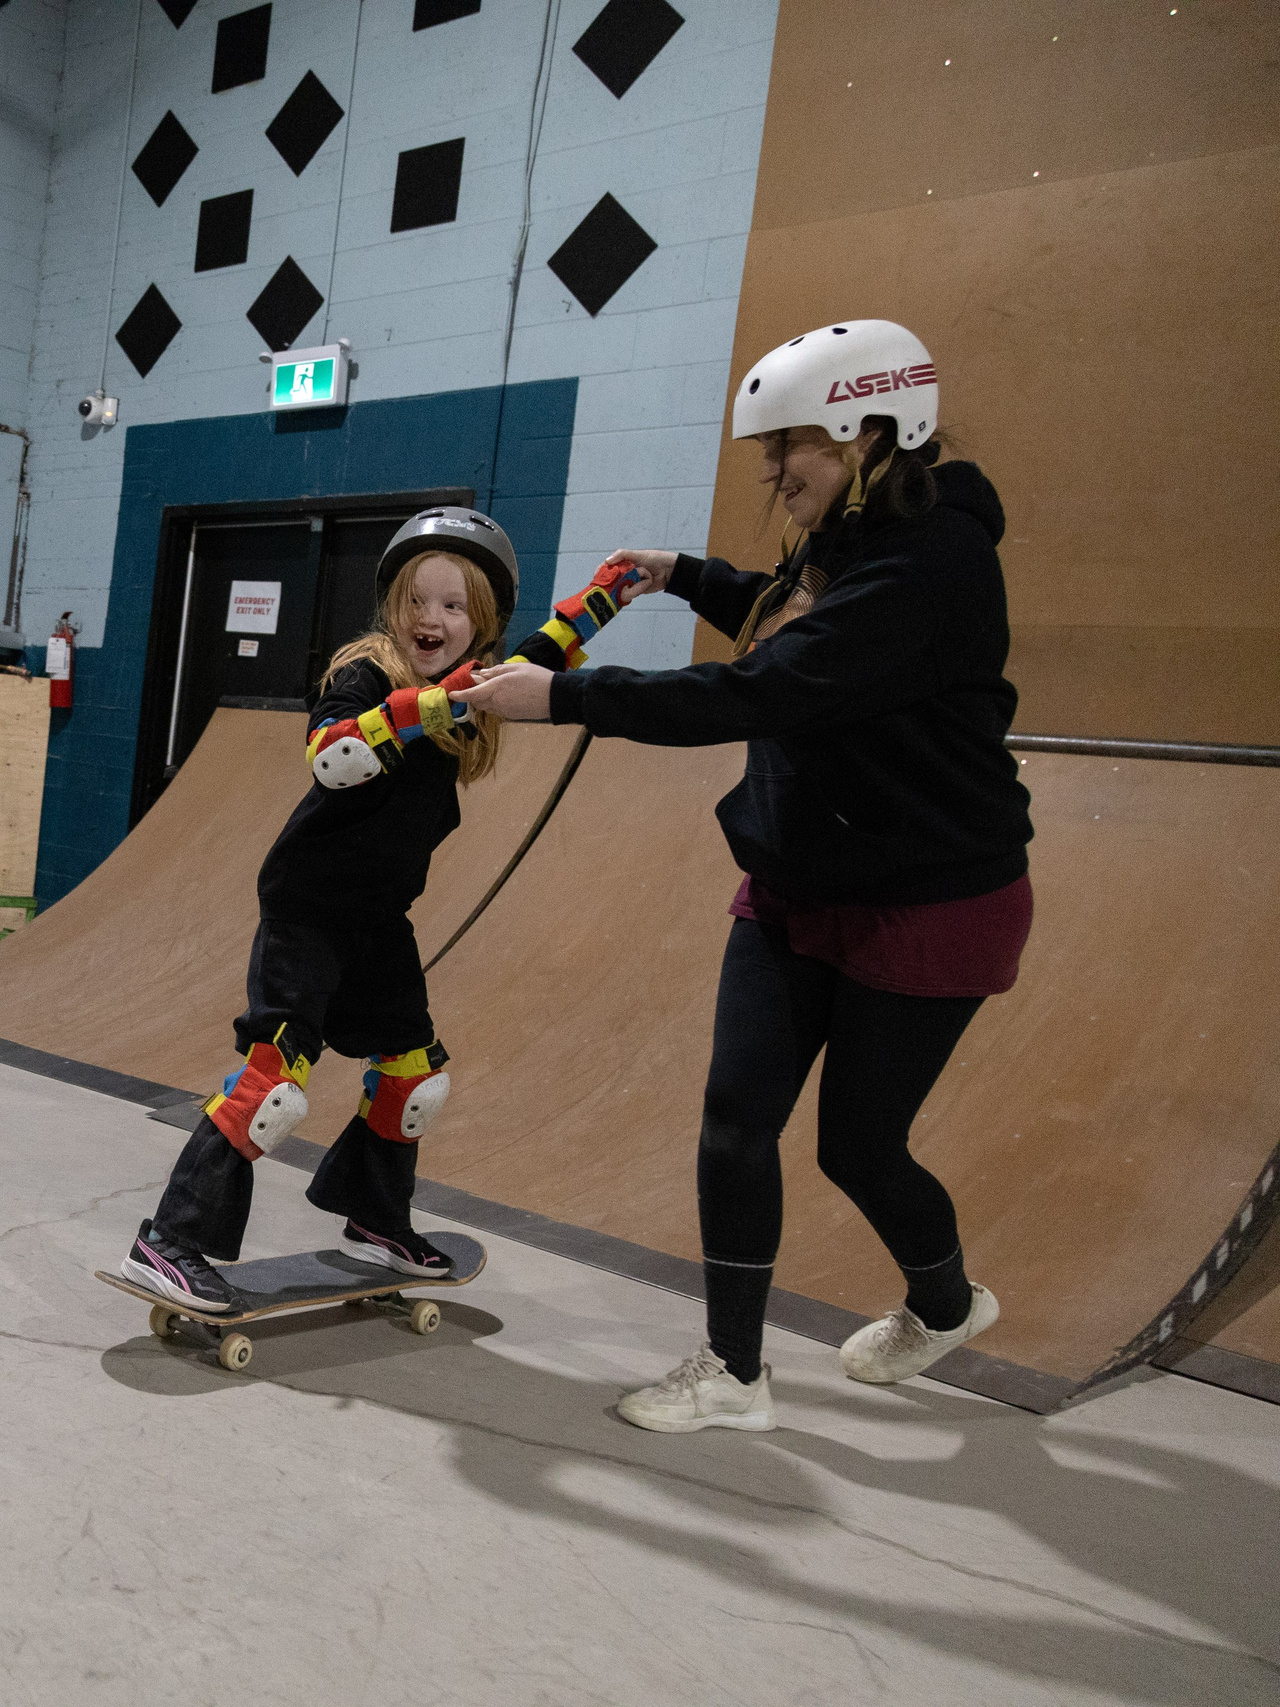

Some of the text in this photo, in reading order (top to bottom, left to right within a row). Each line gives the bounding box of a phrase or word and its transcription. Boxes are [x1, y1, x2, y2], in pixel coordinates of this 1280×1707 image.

[234, 597, 275, 605] EMERGENCY
[236, 607, 271, 615] EXIT ONLY
[295, 1059, 304, 1073] R
